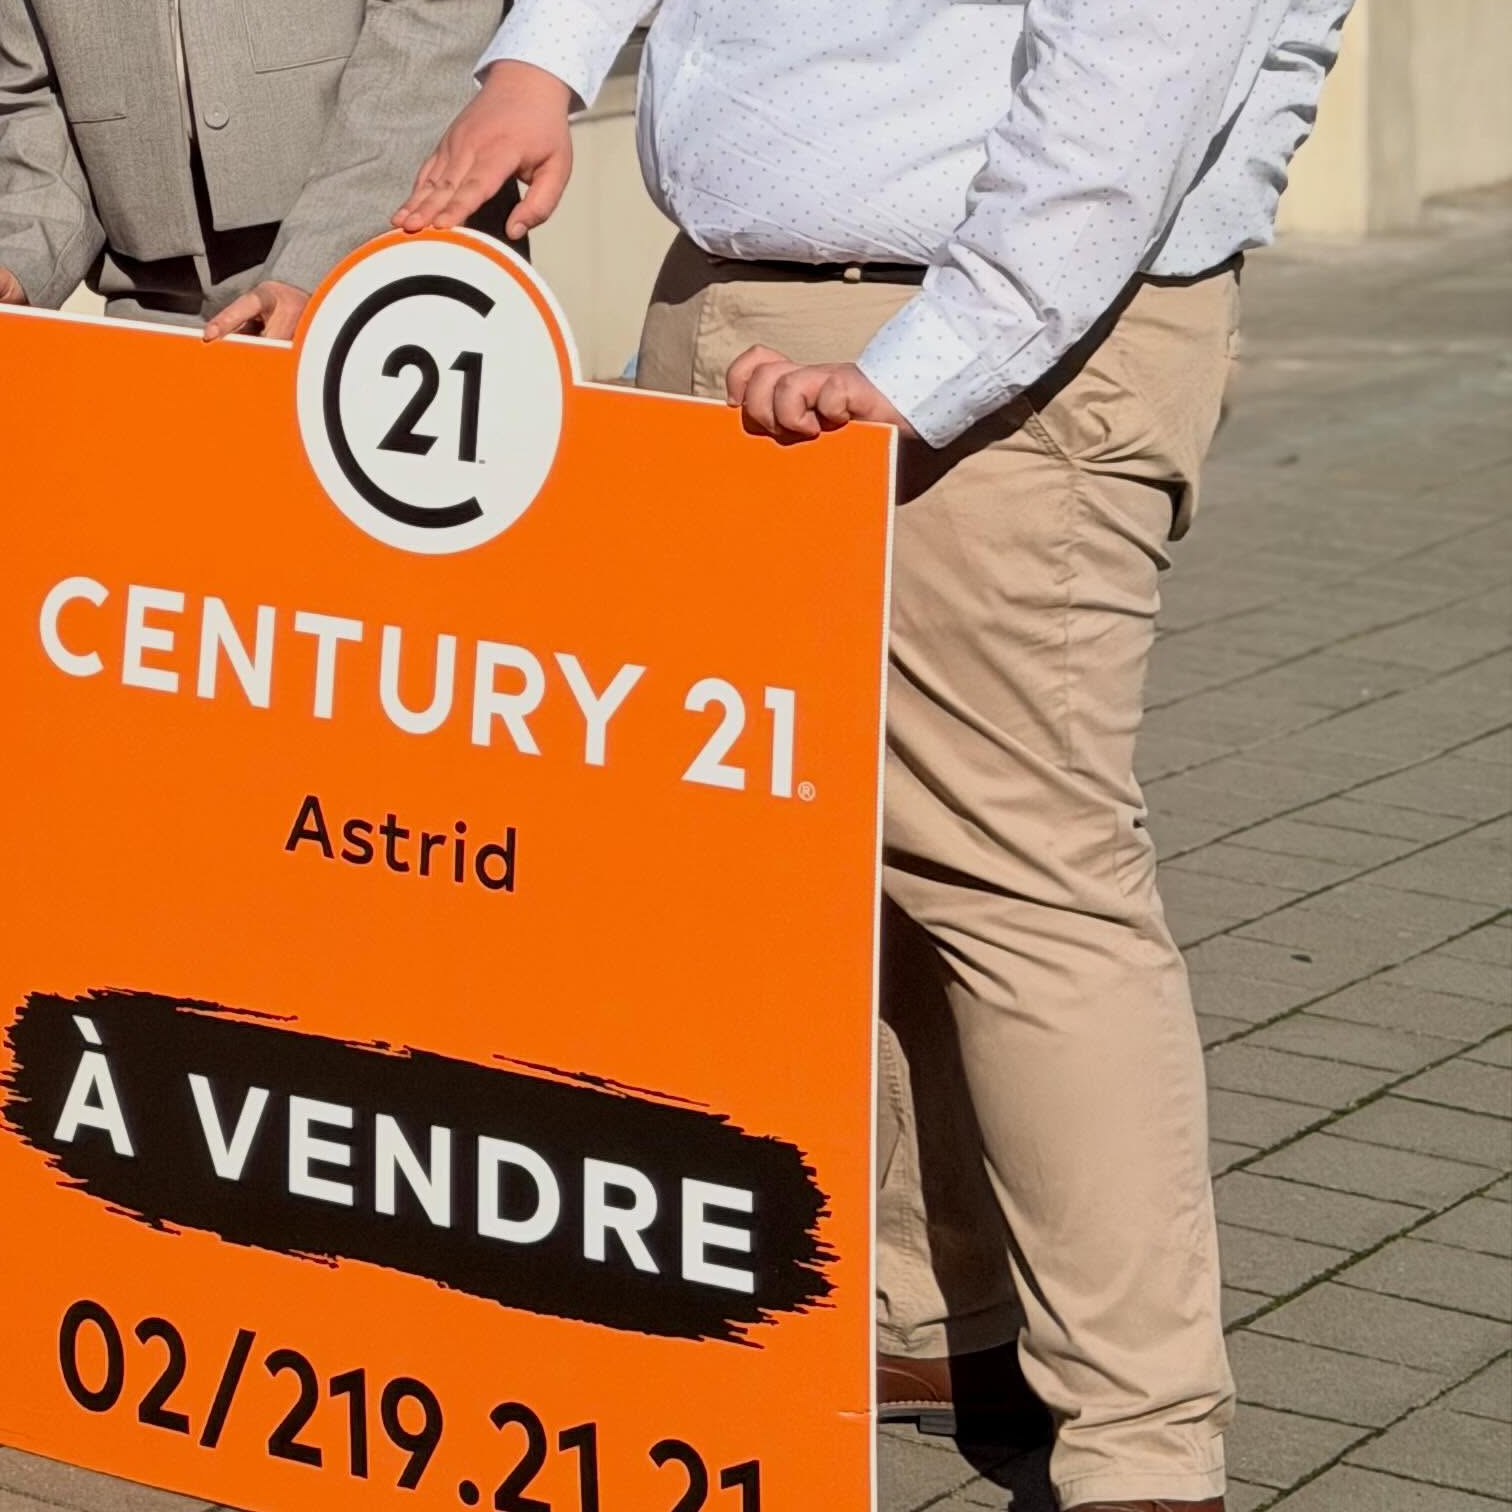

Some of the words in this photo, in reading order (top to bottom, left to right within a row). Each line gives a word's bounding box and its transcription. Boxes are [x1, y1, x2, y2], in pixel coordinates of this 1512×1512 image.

[39, 576, 645, 766] CENTURY
[285, 794, 517, 893] Astrid
[53, 1015, 134, 1157] À
[188, 1072, 755, 1294] VENDRE
[59, 1298, 762, 1512] 02/219.2121
